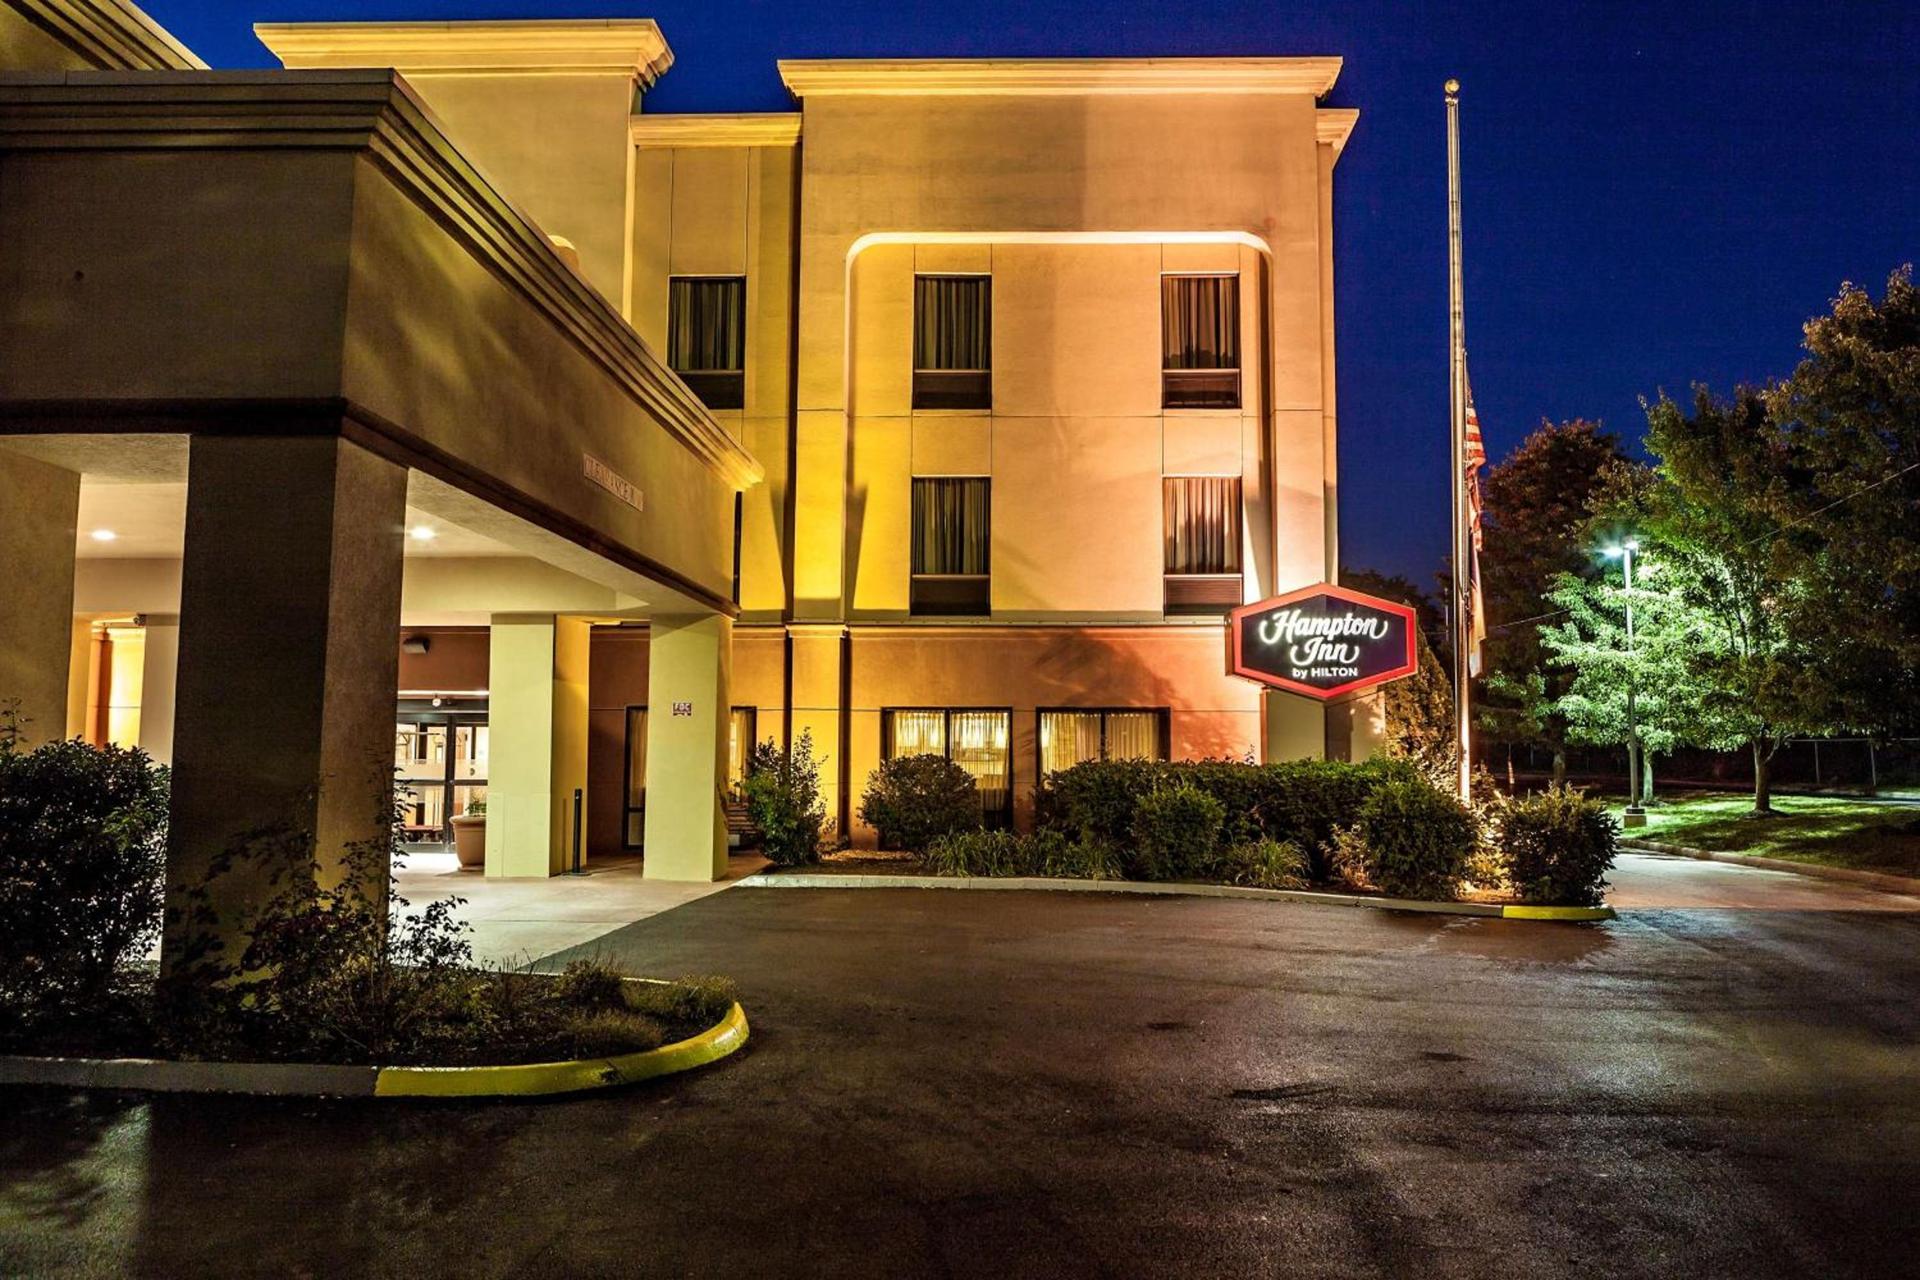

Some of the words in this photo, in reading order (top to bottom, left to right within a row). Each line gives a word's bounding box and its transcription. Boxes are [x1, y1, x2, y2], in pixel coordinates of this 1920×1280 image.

[1258, 609, 1389, 644] Hampton
[1290, 637, 1360, 666] Inn
[1292, 667, 1307, 679] by
[1311, 667, 1358, 677] HILTON
